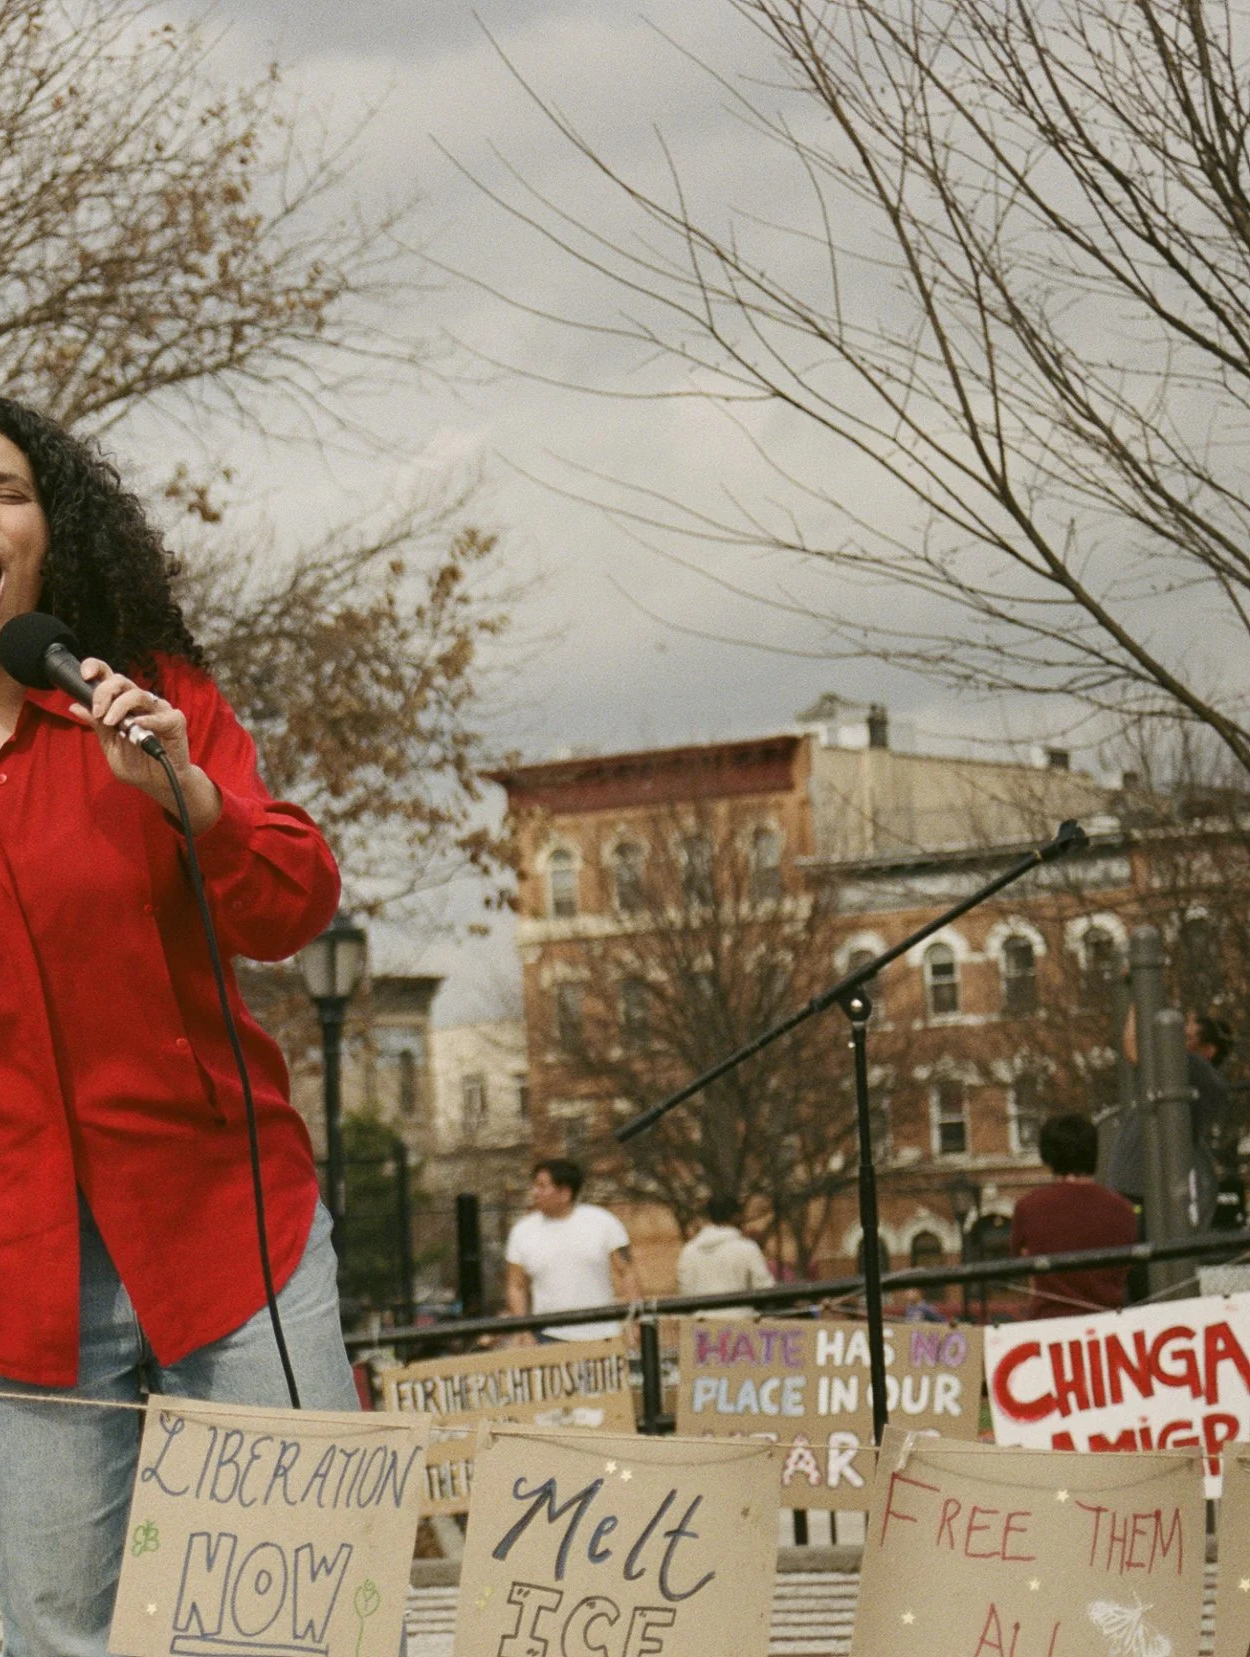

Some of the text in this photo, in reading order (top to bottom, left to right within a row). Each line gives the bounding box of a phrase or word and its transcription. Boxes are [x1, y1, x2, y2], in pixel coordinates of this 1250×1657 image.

[693, 1374, 963, 1418] PLACE IN OUR
[694, 1326, 804, 1368] HATE
[910, 1330, 968, 1368] NO
[141, 1410, 423, 1509] LIBERATION
[492, 1476, 717, 1602] Melt
[880, 1471, 1183, 1575] FREE THEM
[172, 1532, 353, 1644] NOW
